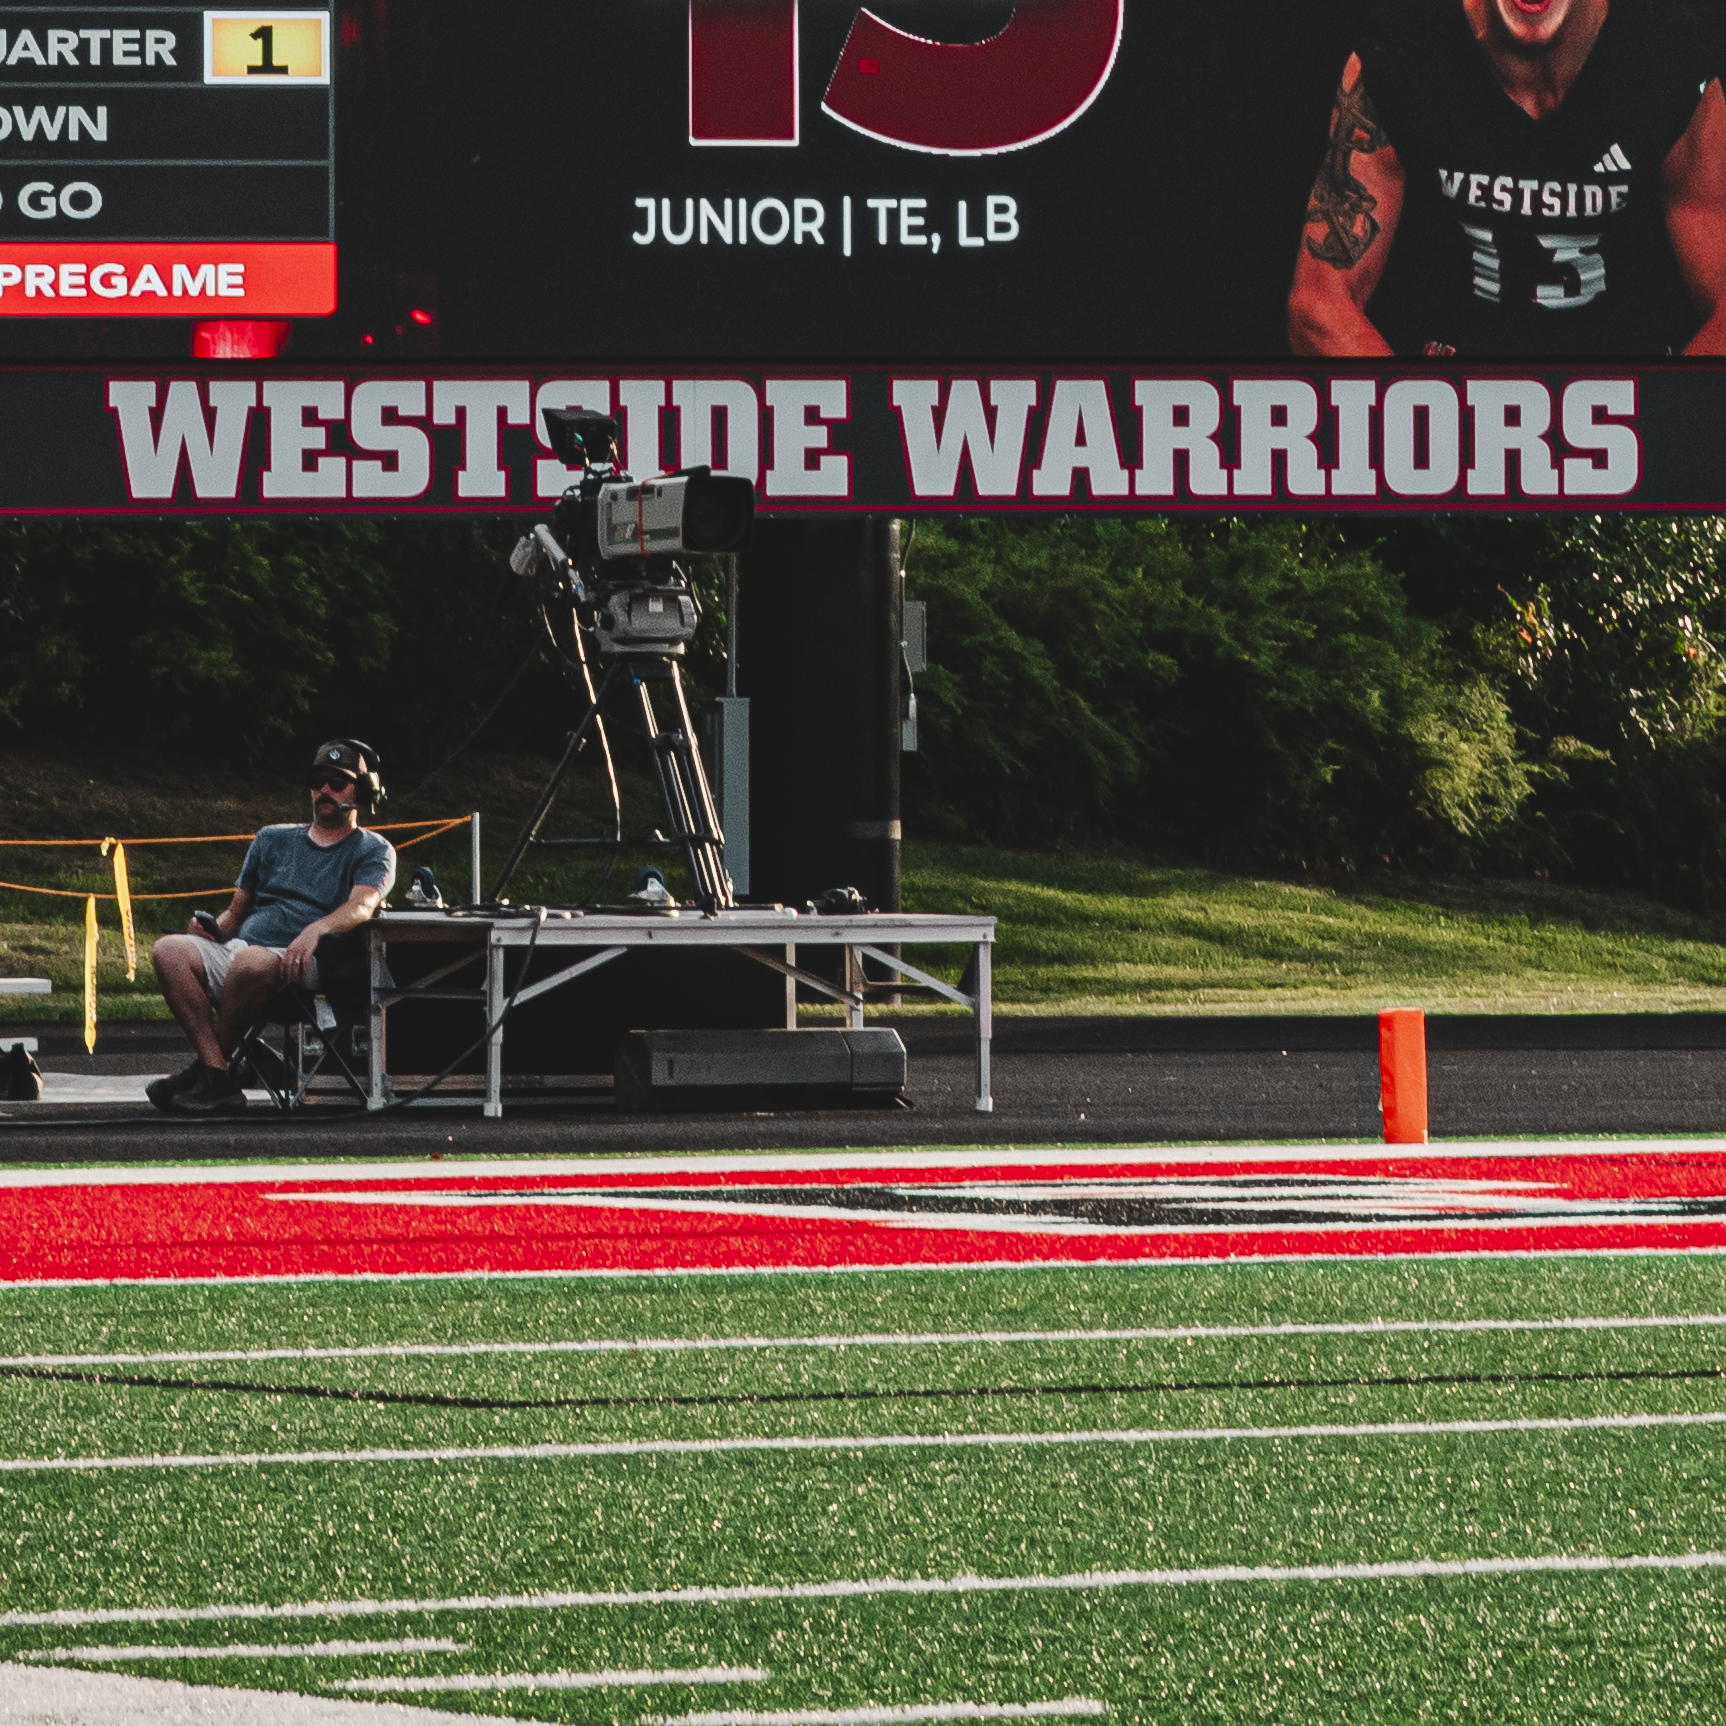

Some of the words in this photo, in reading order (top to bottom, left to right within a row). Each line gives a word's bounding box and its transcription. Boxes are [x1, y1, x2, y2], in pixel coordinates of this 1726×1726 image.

[247, 26, 289, 75] 1
[17, 181, 103, 219] GO
[1438, 168, 1629, 218] WESTSIDE
[632, 197, 825, 246] JUNIOR
[866, 198, 942, 255] TE,
[957, 194, 1020, 248] LB
[1461, 223, 1607, 309] 13
[106, 376, 852, 503] WESTSIDE
[889, 376, 1643, 500] WARRIORS
